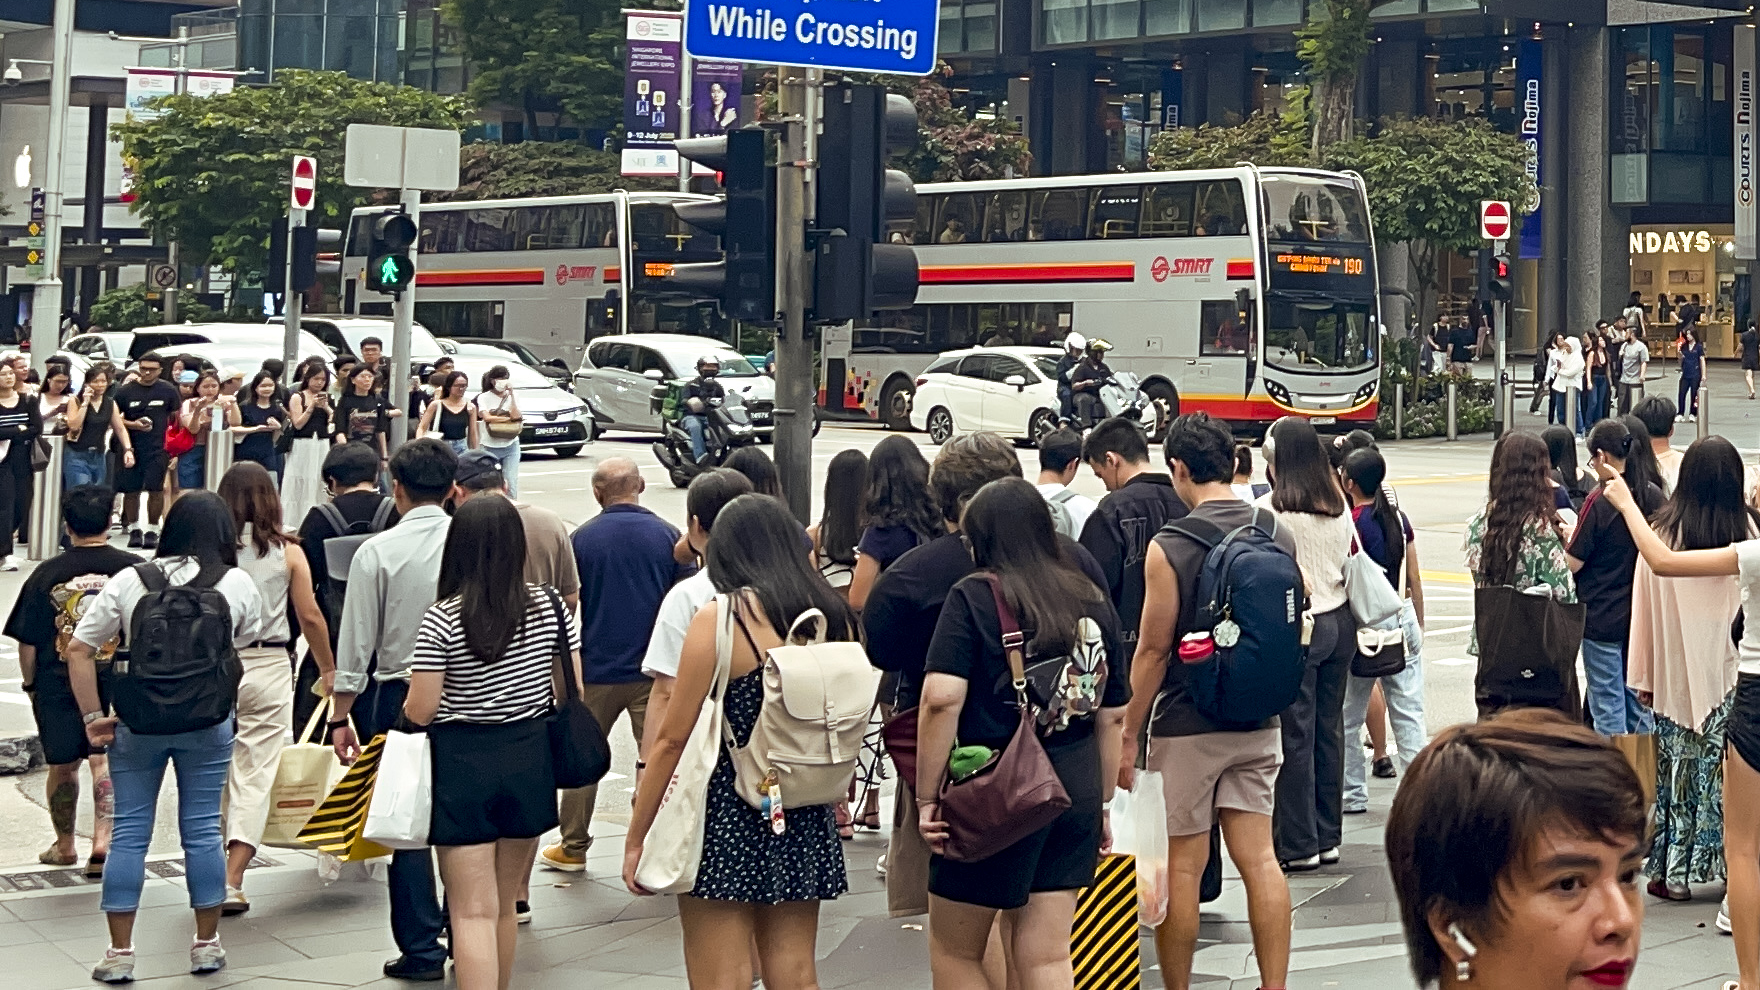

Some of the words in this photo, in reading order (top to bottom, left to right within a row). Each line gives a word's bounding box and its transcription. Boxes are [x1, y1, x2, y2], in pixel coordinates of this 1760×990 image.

[708, 4, 787, 41] While
[795, 12, 918, 60] Crossing
[1739, 132, 1753, 204] COURTS
[1629, 230, 1711, 254] NDAYS
[1170, 257, 1215, 274] SMRT
[1343, 257, 1363, 275] 190
